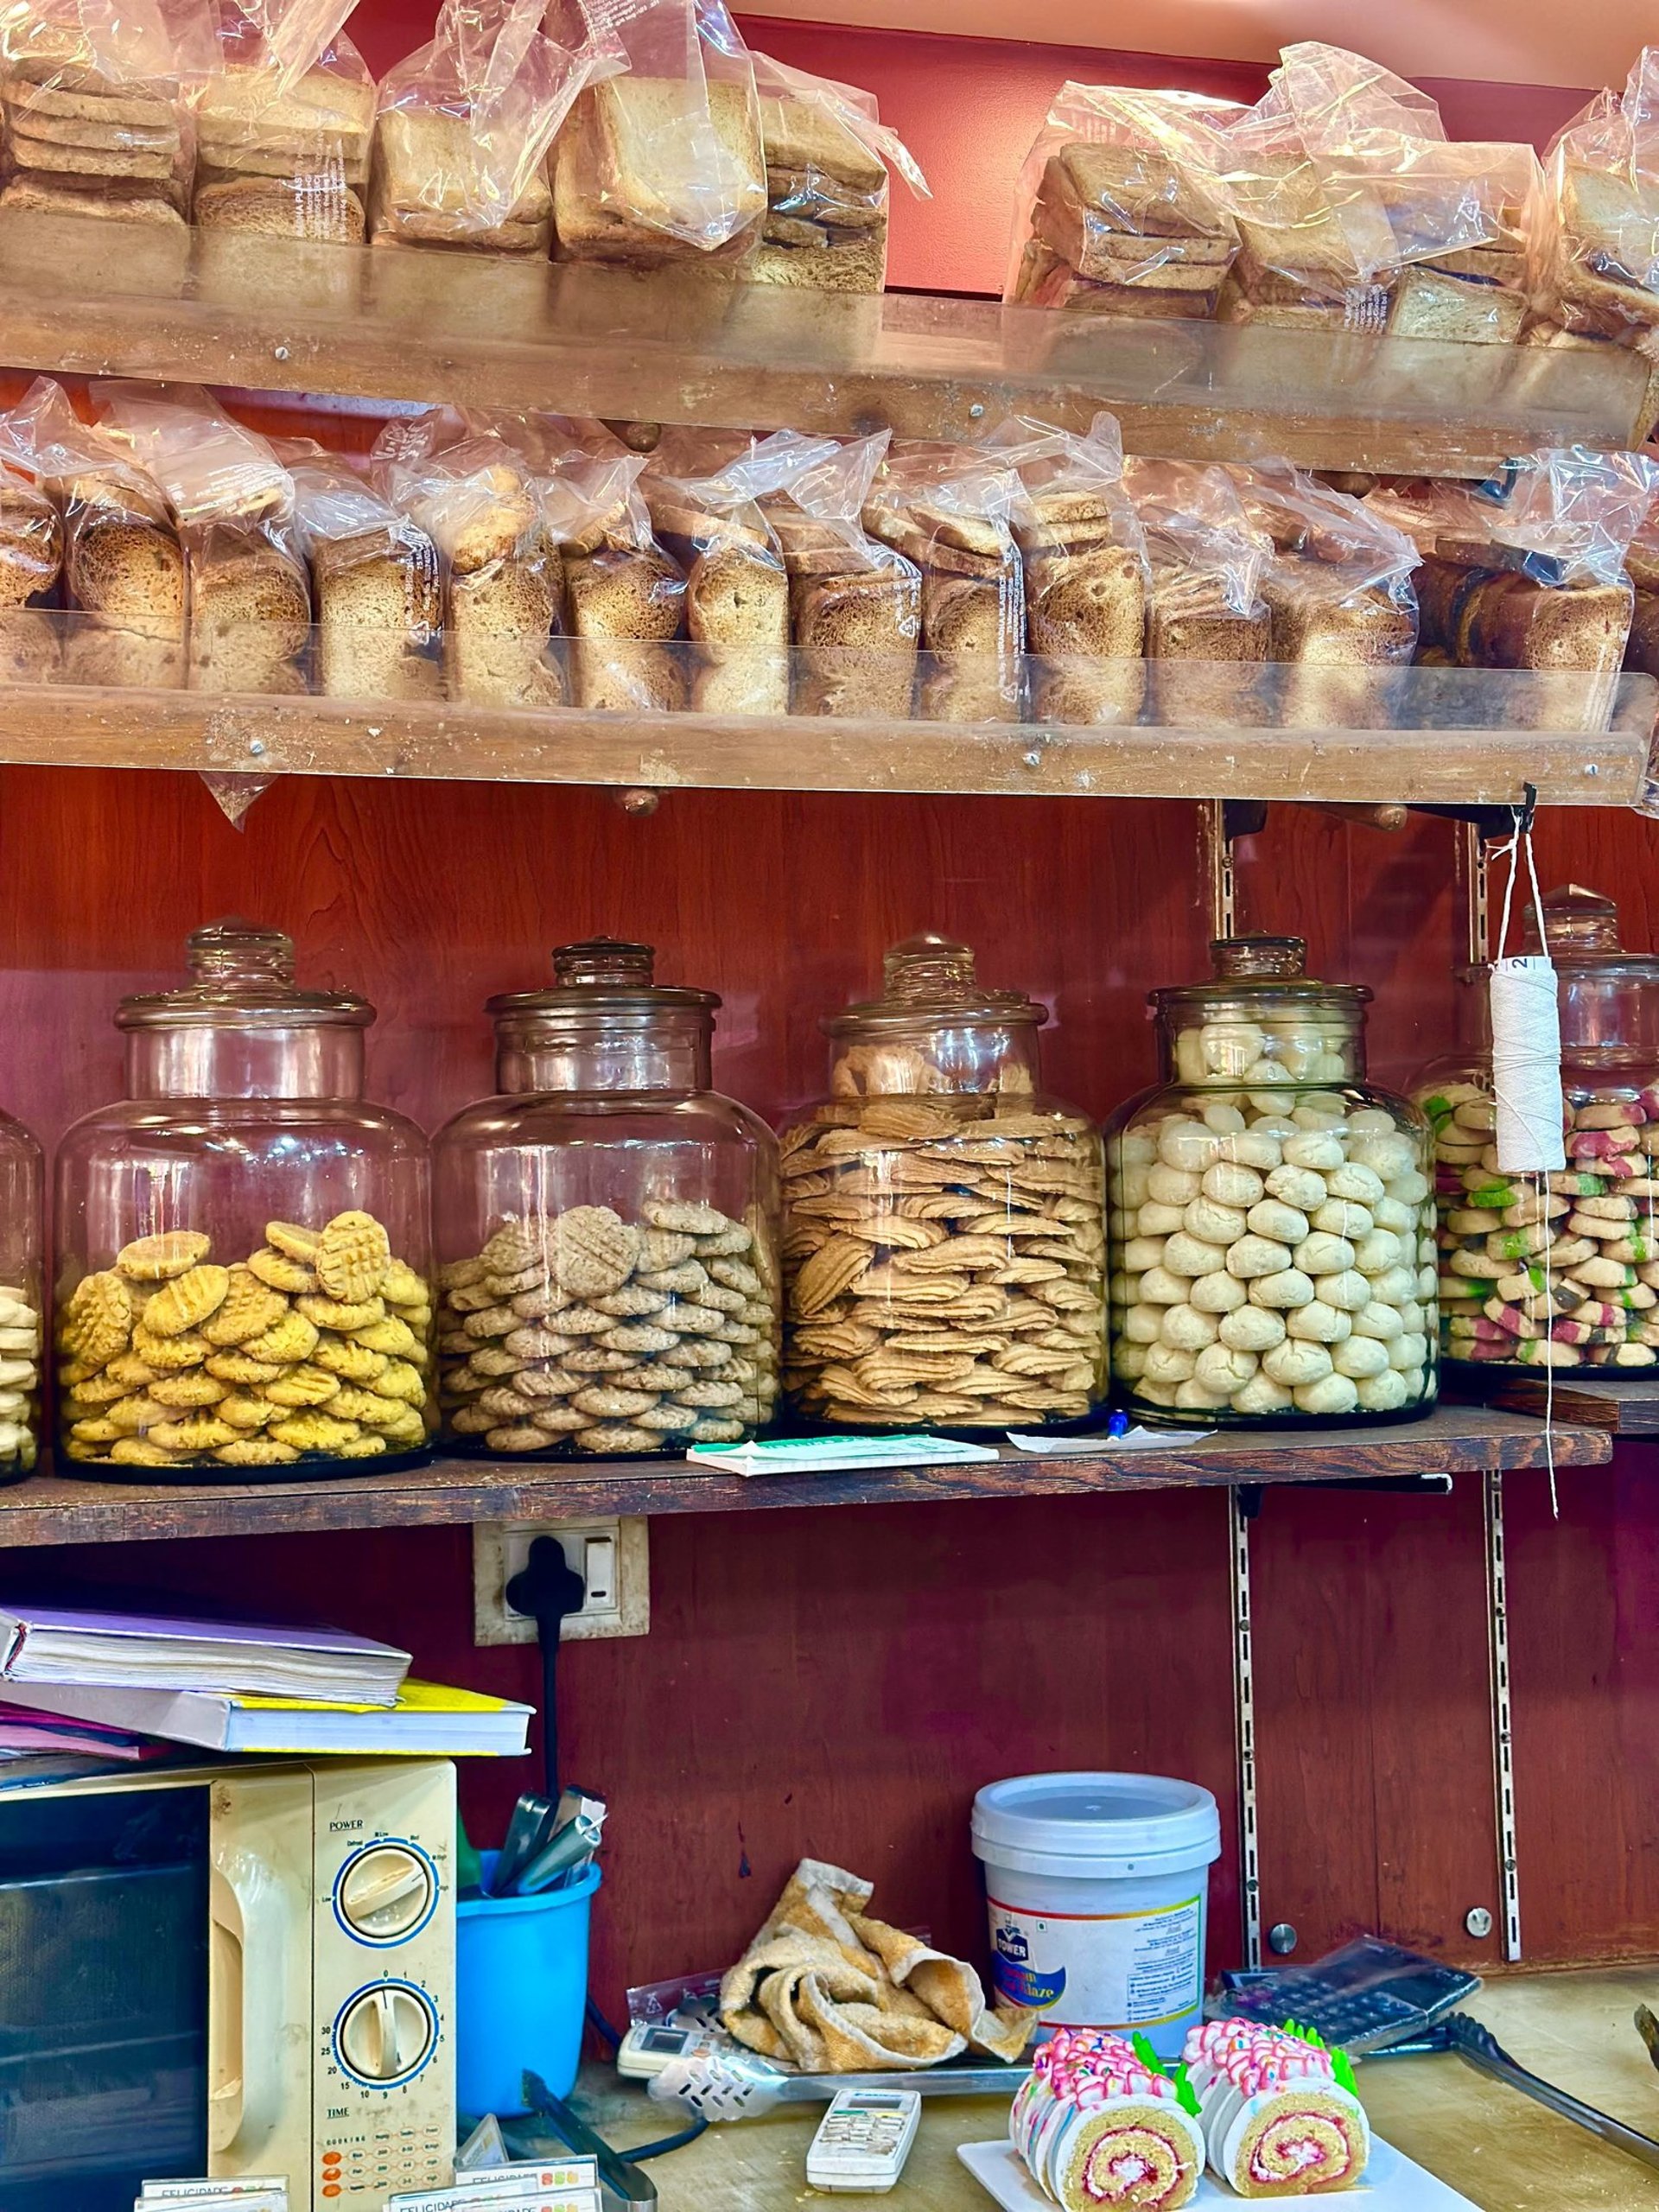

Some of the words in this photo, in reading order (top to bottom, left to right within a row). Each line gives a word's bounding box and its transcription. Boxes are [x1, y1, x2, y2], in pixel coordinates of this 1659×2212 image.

[329, 1819, 363, 1830] POWER
[998, 1938, 1027, 1958] TOWER
[321, 2026, 331, 2035] 30
[360, 2090, 370, 2099] 10
[383, 2091, 388, 2100] 9
[327, 2107, 350, 2119] TIME
